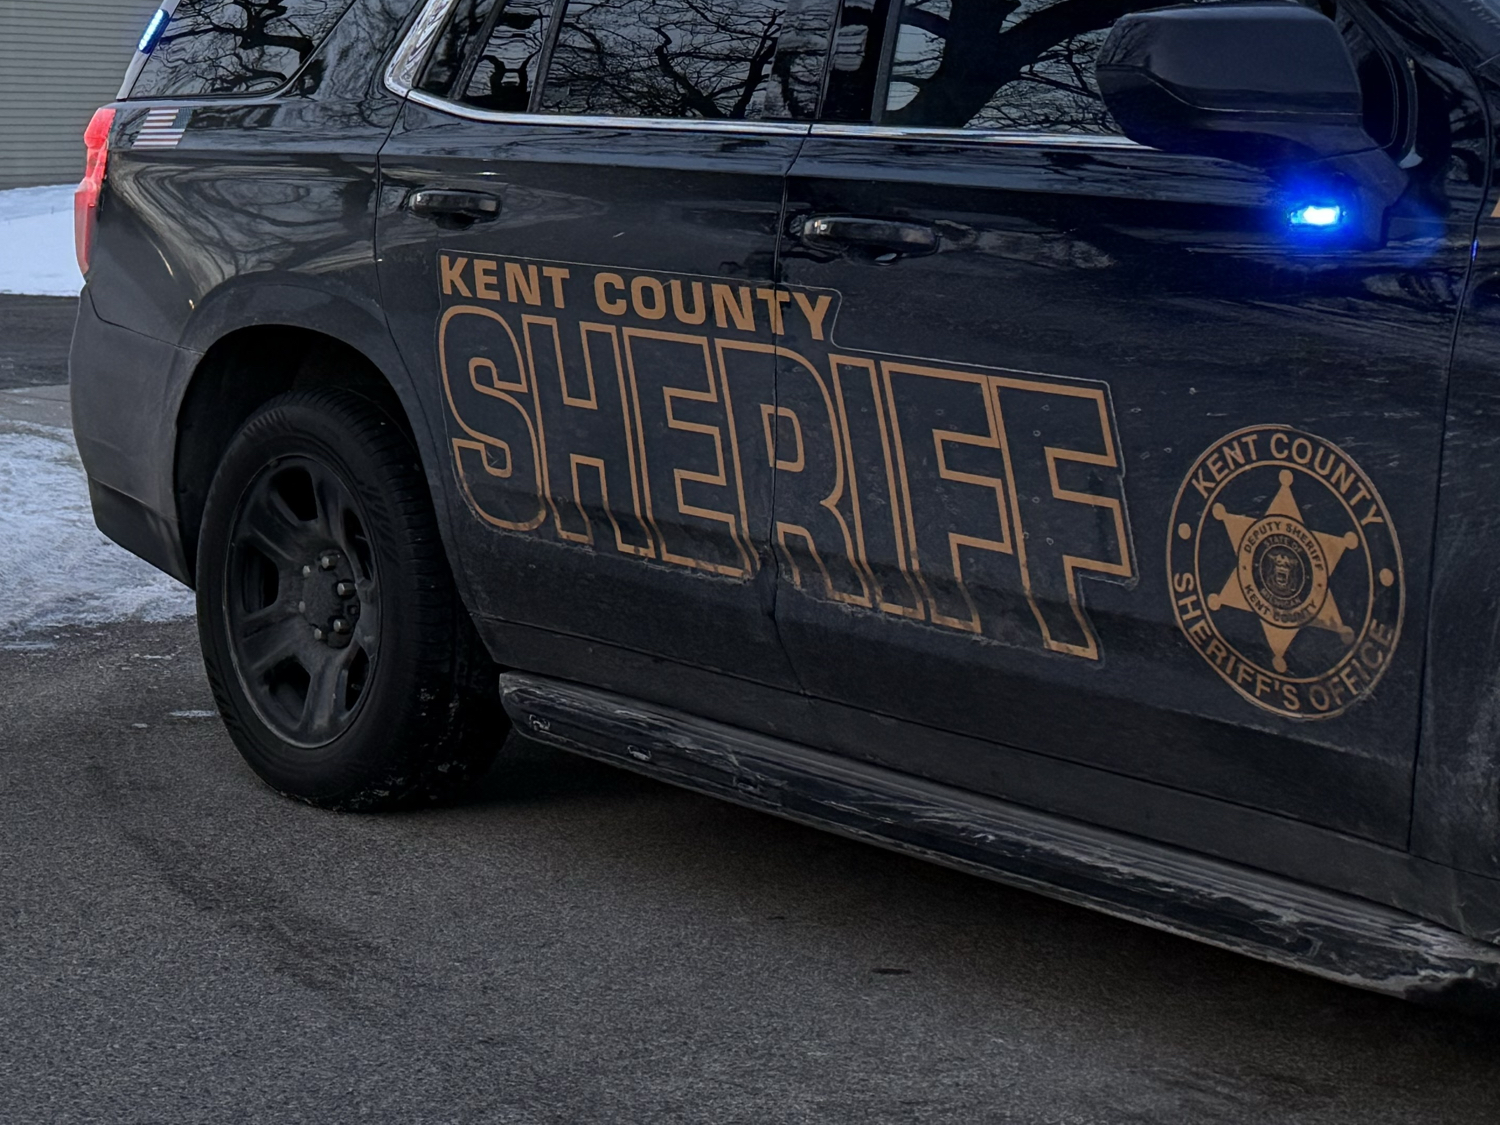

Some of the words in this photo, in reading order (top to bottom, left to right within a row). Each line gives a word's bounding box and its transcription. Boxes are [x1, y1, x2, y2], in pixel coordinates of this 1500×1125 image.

[439, 254, 570, 309] KENT
[594, 271, 832, 342] COUNTY
[438, 304, 1135, 660] SHERIFF
[1191, 434, 1258, 499] KENT
[1270, 432, 1385, 526] COUNTY
[1244, 521, 1282, 554] DEPUTY
[1286, 523, 1324, 571] SHERIFF
[1174, 572, 1300, 711] SHERIFF'S
[1308, 618, 1395, 711] OFFICE
[1244, 584, 1271, 616] KENT
[1273, 599, 1317, 623] COUNTY
